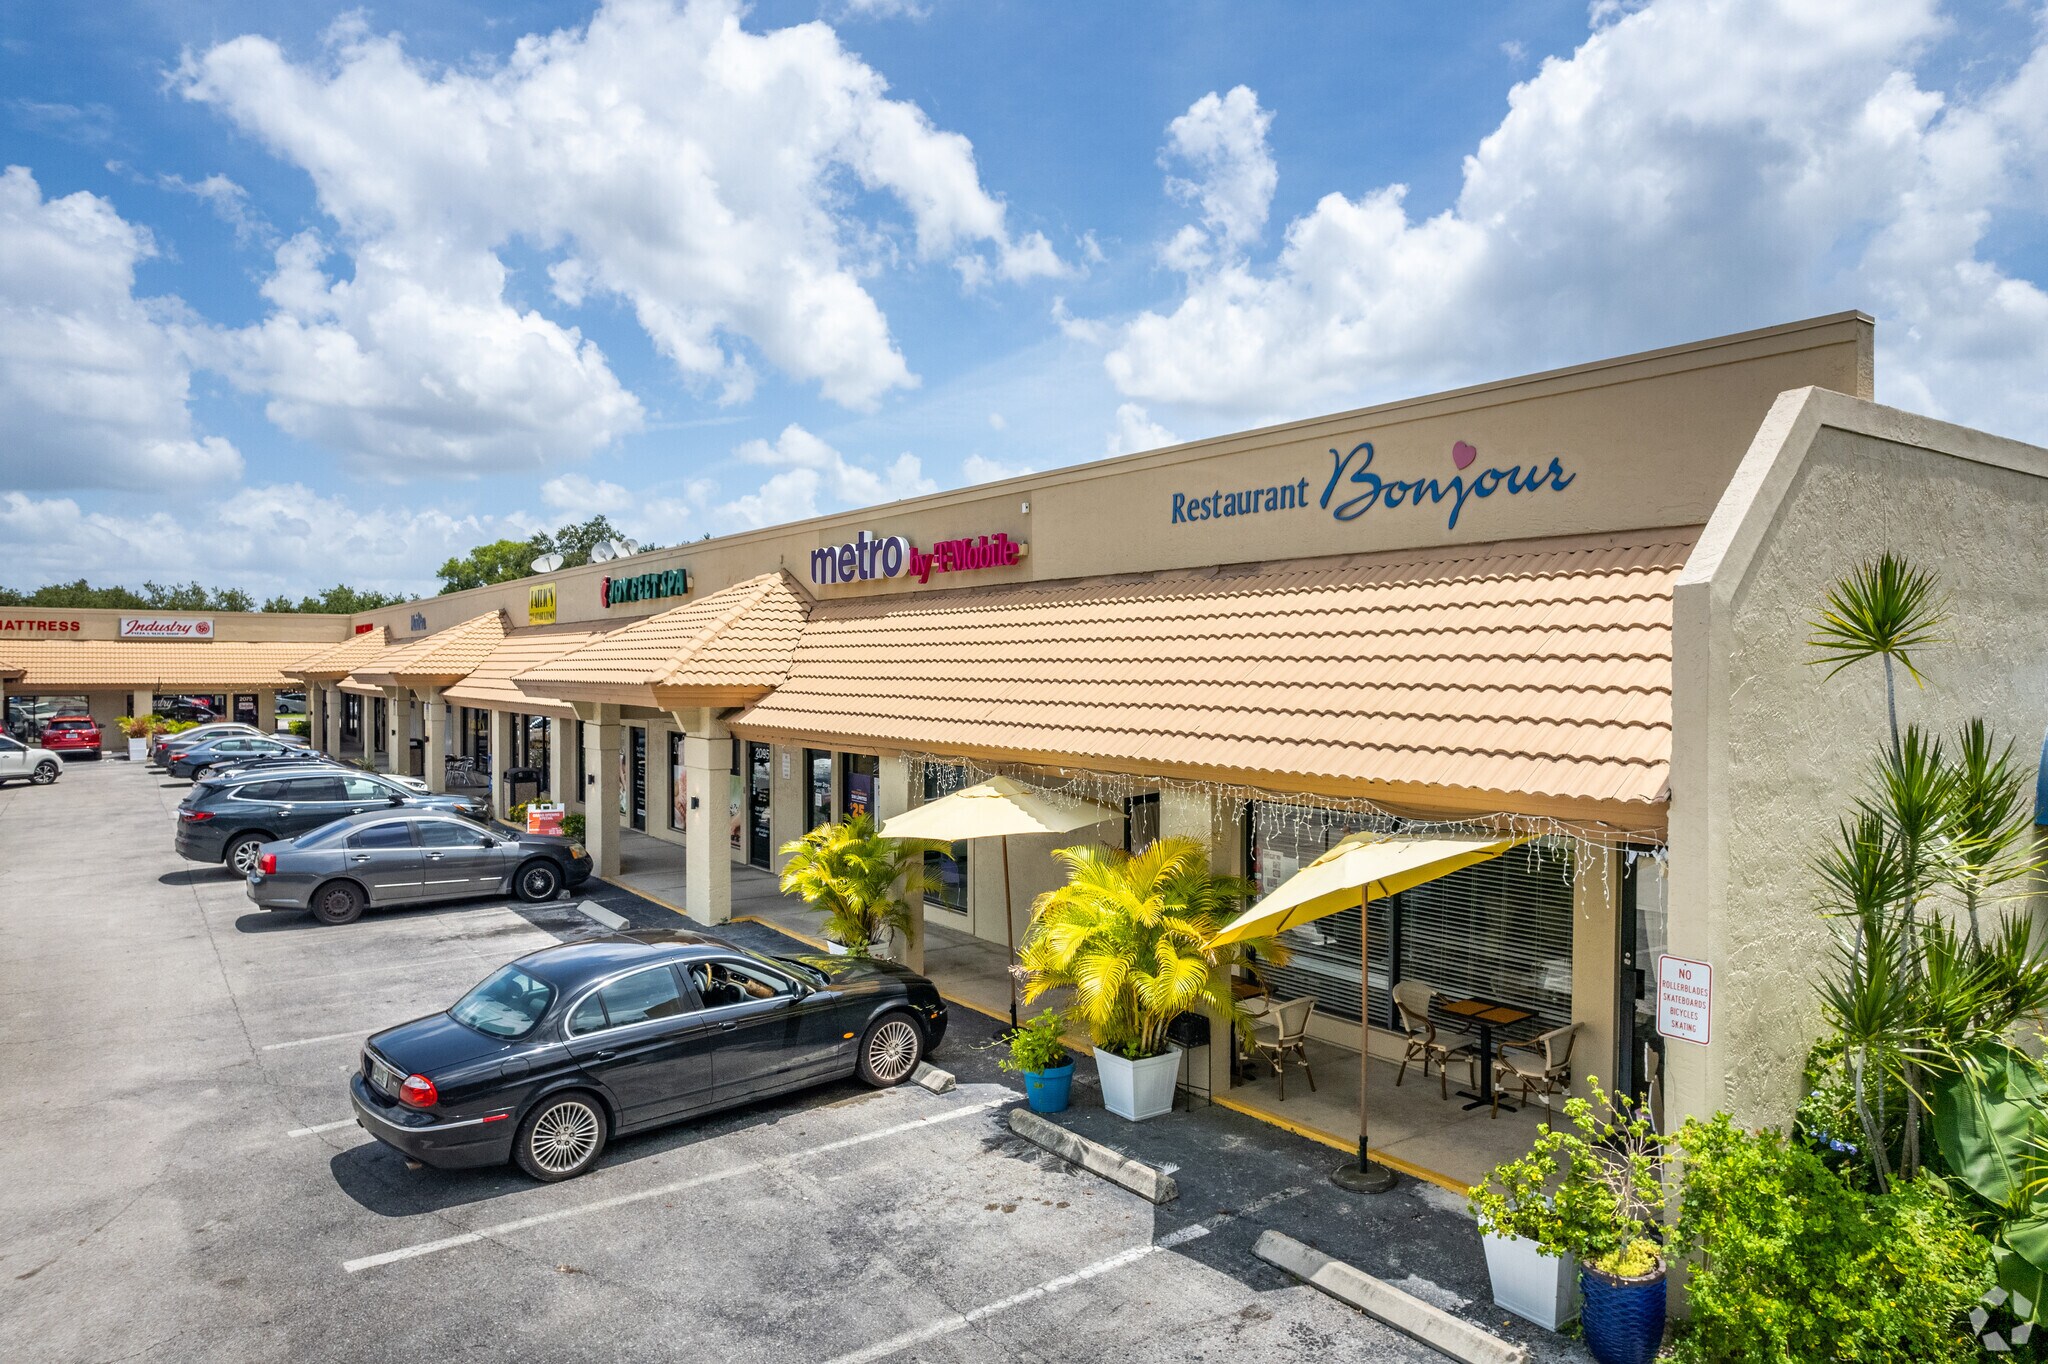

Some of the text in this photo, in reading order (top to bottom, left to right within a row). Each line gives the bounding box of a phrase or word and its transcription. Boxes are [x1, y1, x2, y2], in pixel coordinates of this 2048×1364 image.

[1171, 440, 1576, 530] Restaurant Bonjour
[810, 530, 909, 584] metro
[909, 547, 933, 584] by
[608, 568, 688, 604] JOY FEET SPA
[0, 619, 80, 631] ATTRESS
[124, 619, 192, 635] Industry
[1678, 968, 1692, 980] NO
[1662, 980, 1708, 997] ROLLERBLADES
[1663, 993, 1706, 1009] SKATEBOARDS
[1670, 1006, 1698, 1020] BICYCLES
[1671, 1020, 1696, 1032] SKATING
